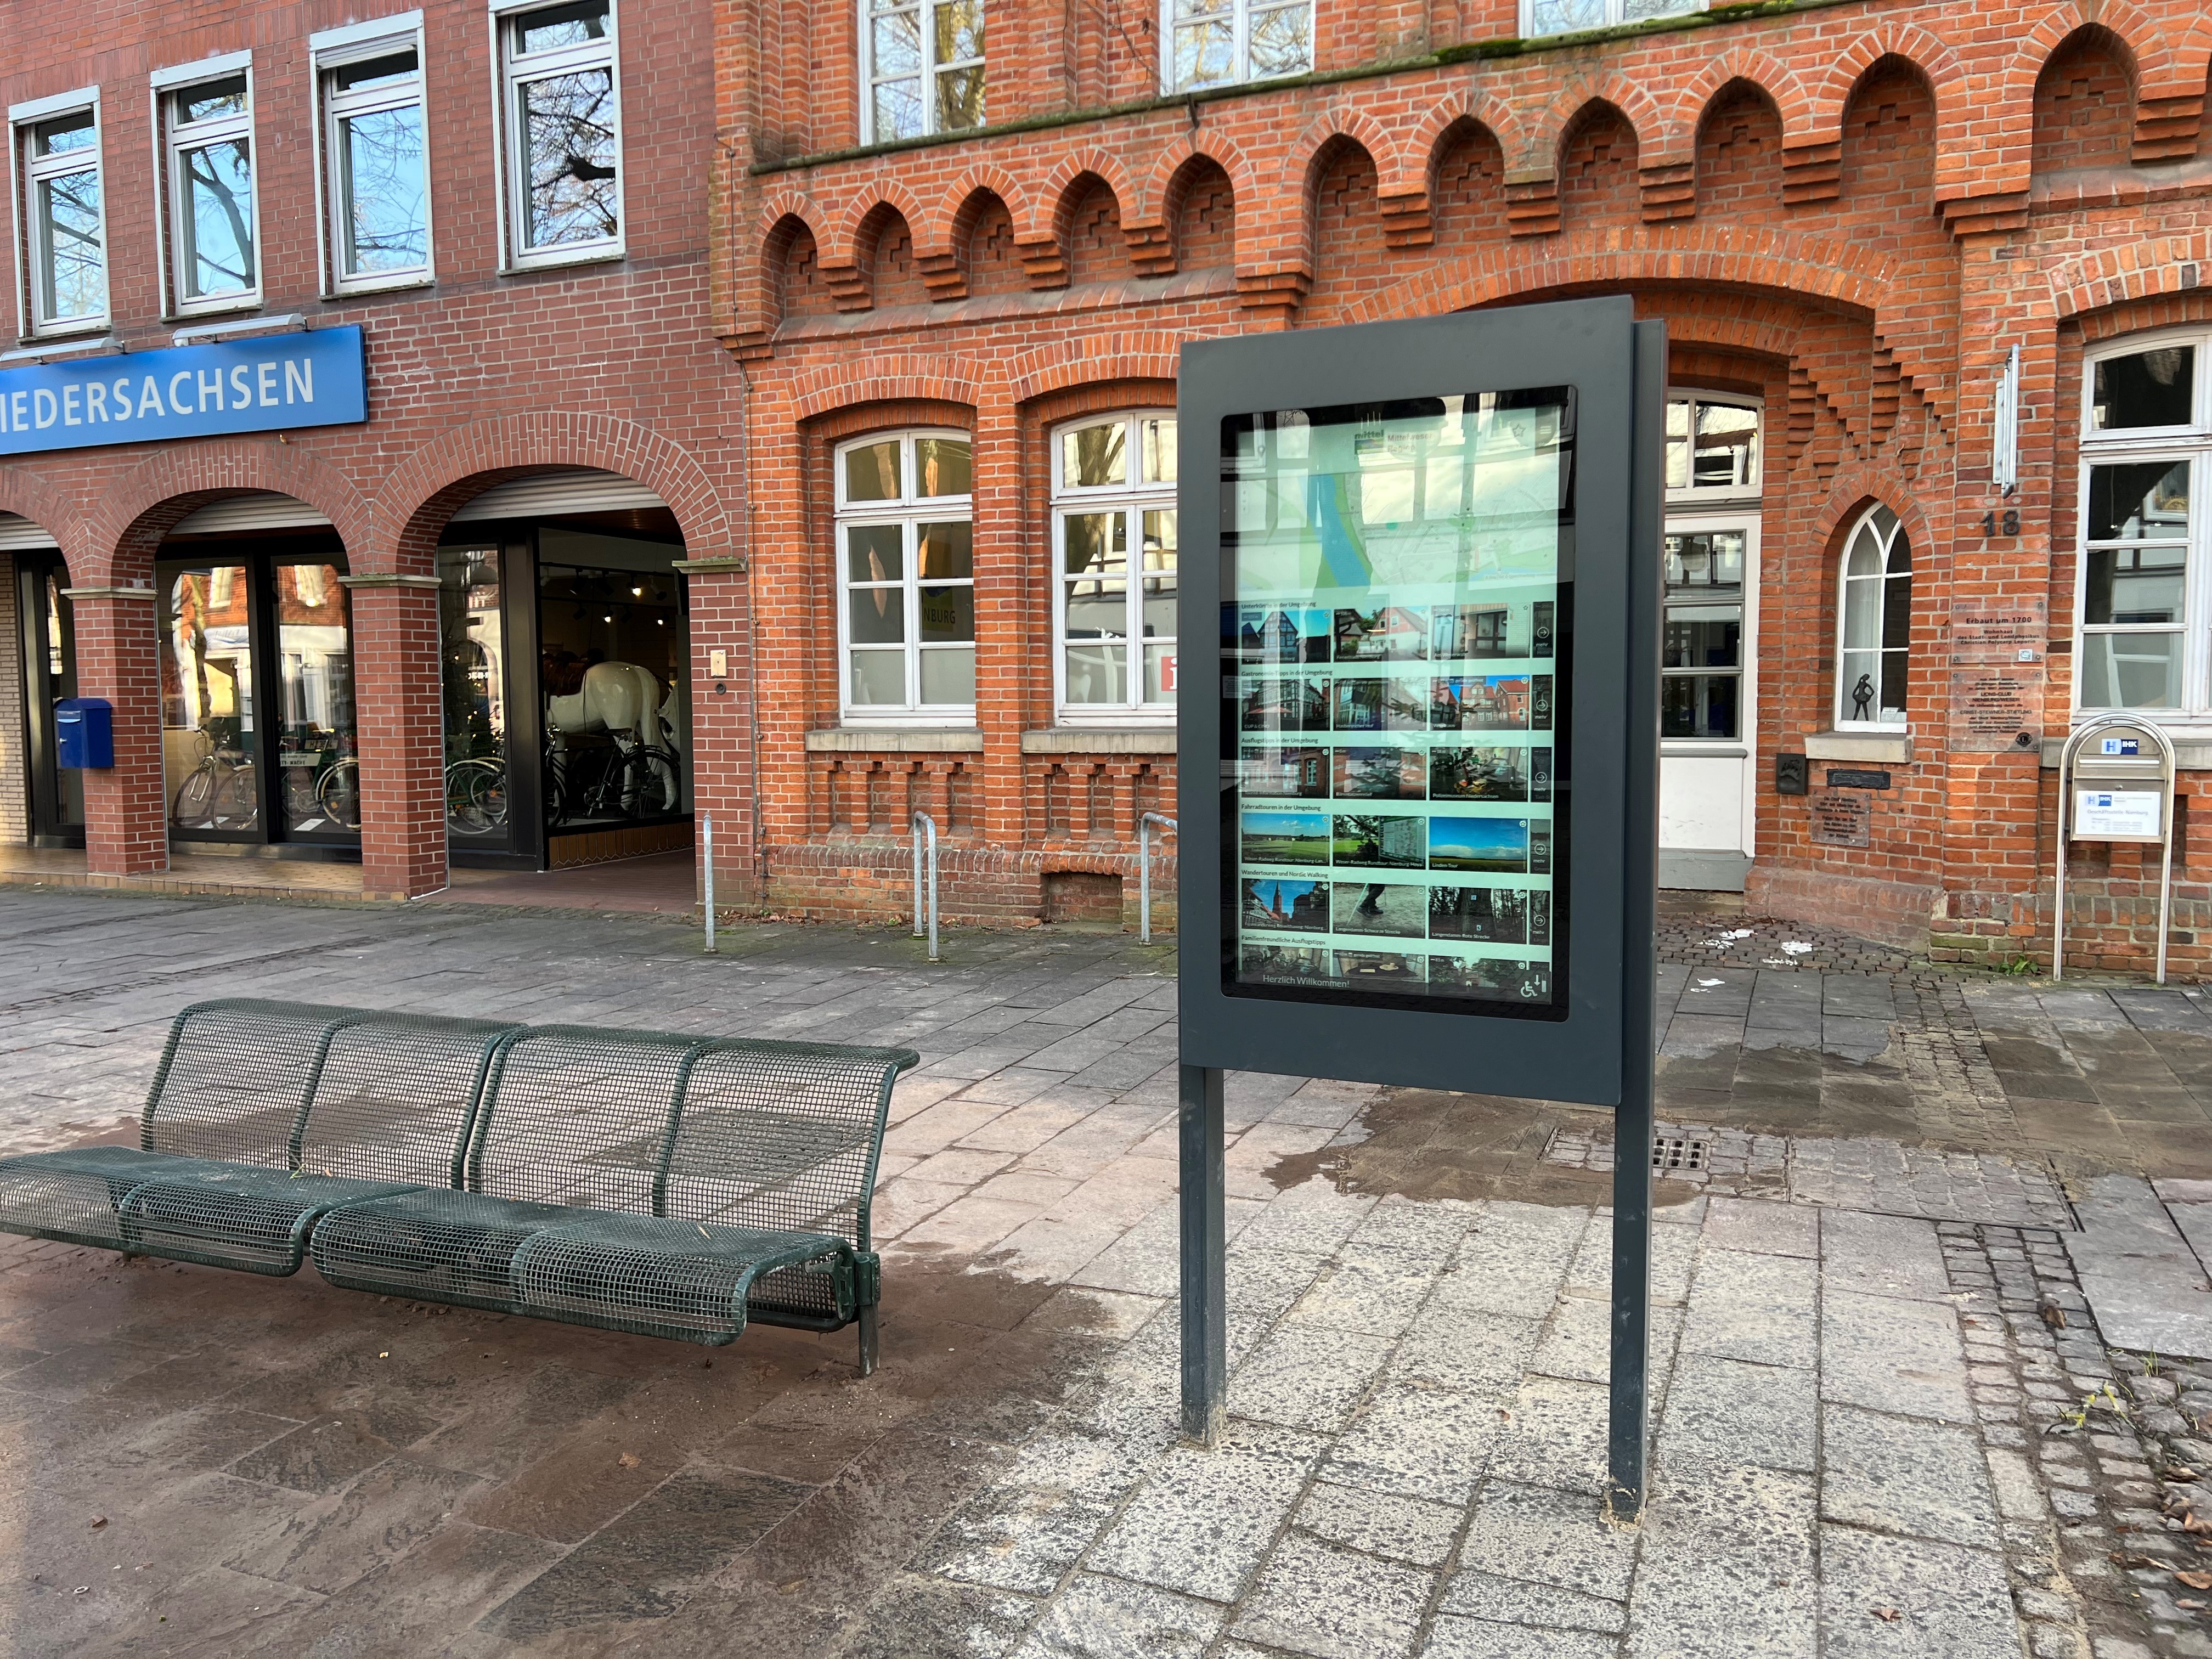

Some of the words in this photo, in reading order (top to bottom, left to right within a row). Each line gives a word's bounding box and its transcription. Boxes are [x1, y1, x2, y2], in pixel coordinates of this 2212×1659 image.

[1355, 430, 1384, 439] mittel
[1980, 511, 2020, 537] 18
[1263, 974, 1295, 984] Herzlich
[1296, 977, 1350, 989] Willkommen!
